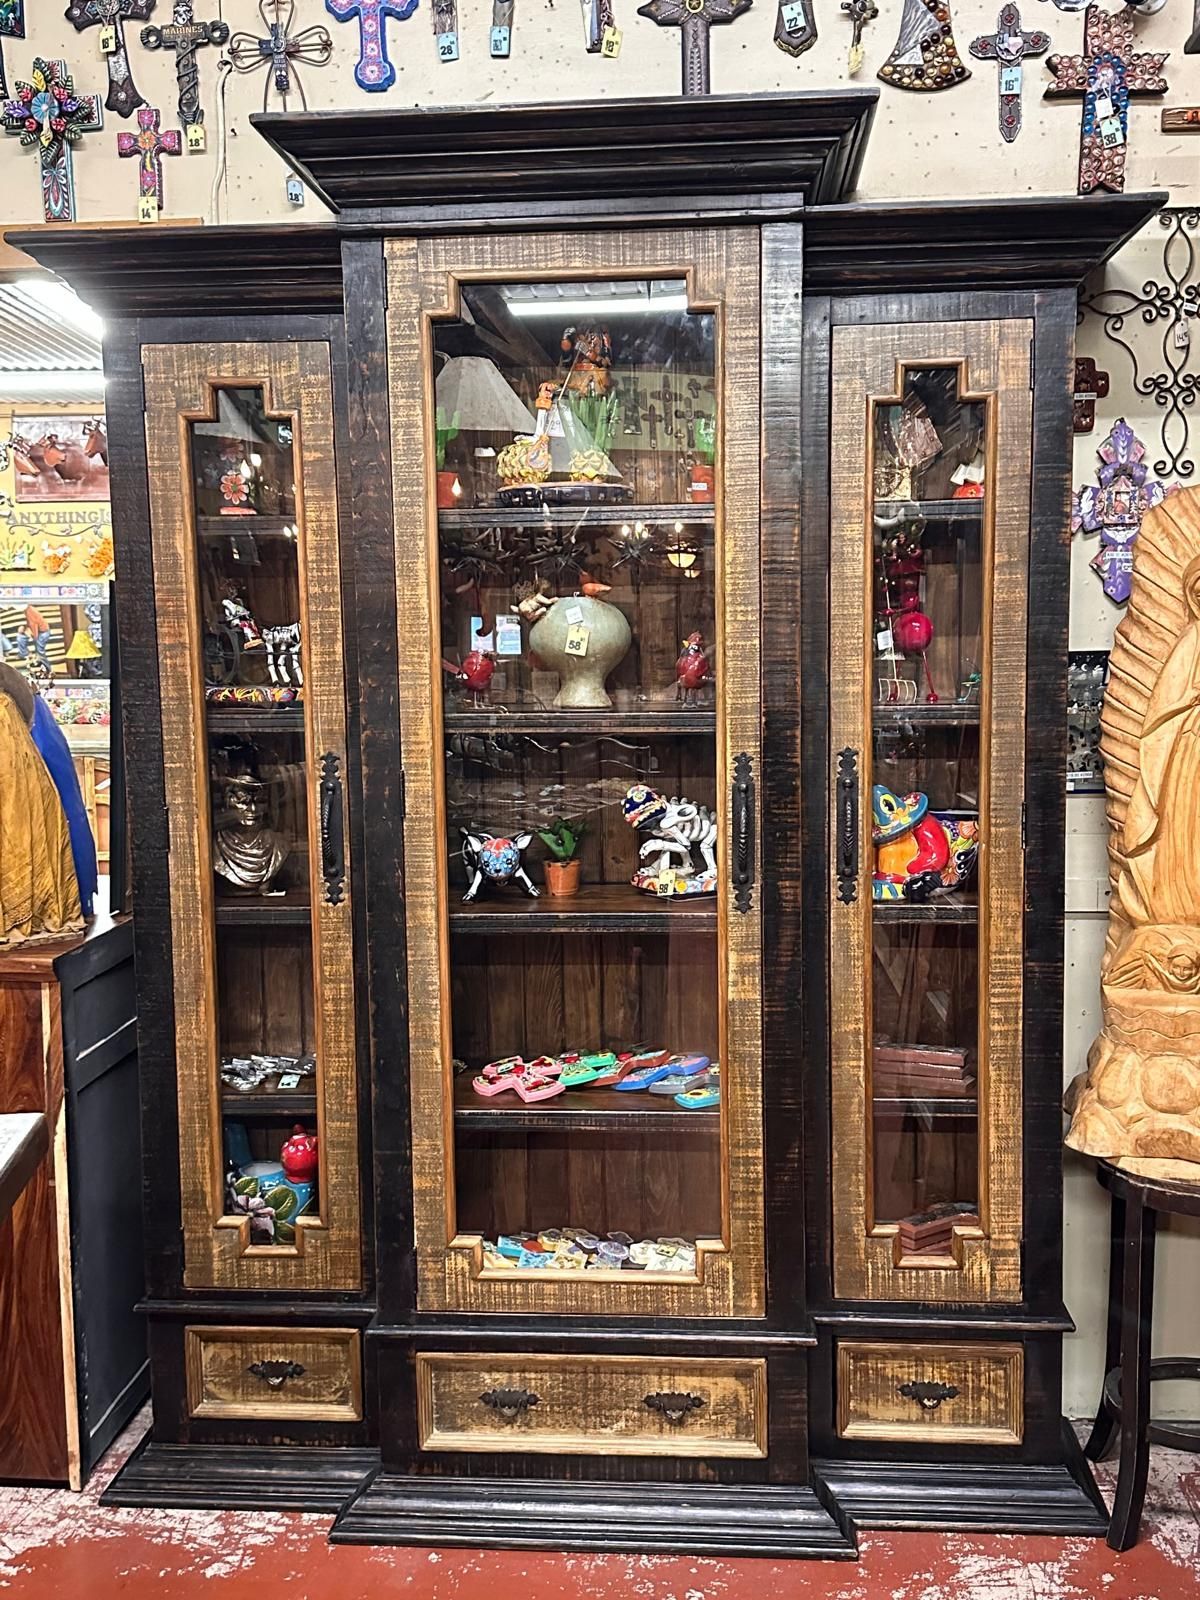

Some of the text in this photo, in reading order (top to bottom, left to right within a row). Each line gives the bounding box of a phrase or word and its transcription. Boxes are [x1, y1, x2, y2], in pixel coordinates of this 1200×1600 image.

[786, 17, 799, 29] 22
[163, 26, 203, 35] MARINES
[440, 45, 453, 55] 28
[1005, 80, 1014, 91] 16
[189, 139, 200, 147] 18
[1104, 133, 1117, 146] 38
[6, 510, 98, 525] ANYTHING
[568, 640, 581, 650] 58
